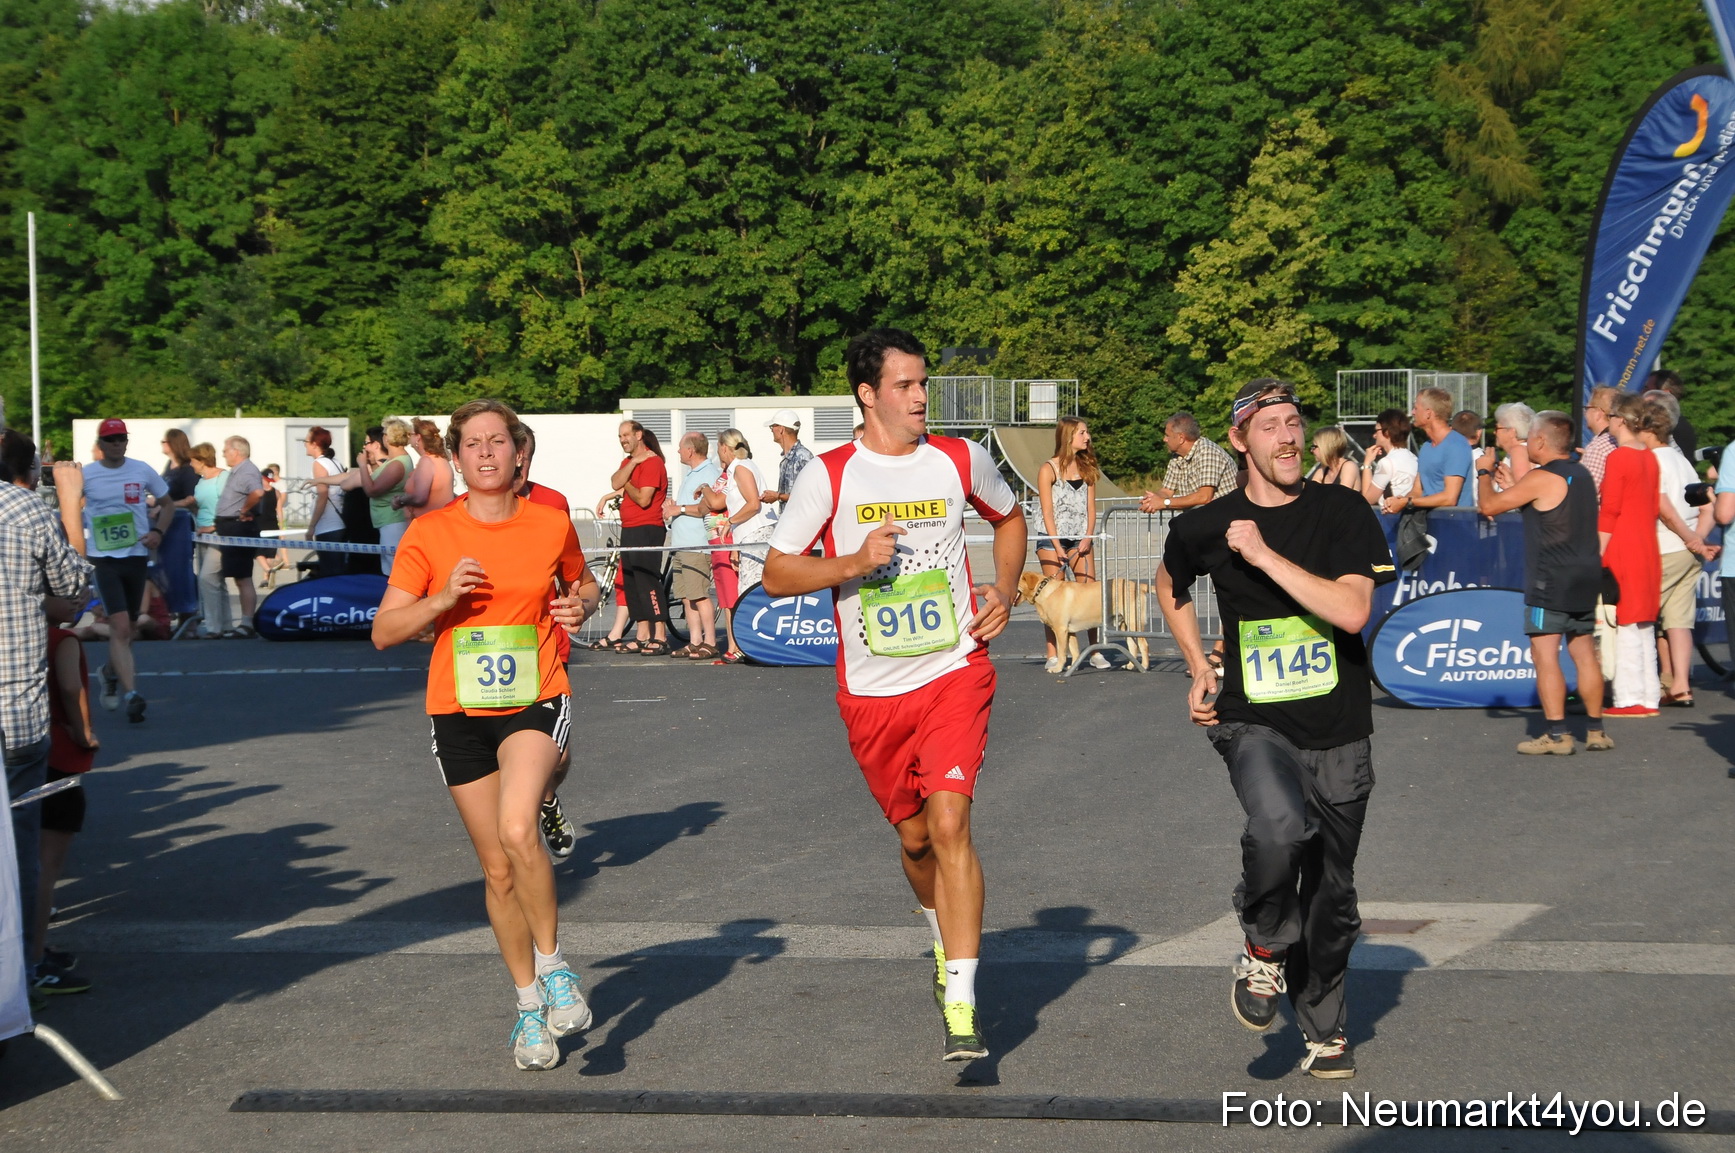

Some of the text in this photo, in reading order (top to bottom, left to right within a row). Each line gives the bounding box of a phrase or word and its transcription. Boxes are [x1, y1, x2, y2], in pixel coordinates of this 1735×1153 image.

[1669, 194, 1700, 239] Druck
[1592, 163, 1708, 342] Frischmann
[861, 502, 939, 520] ONLINE
[906, 520, 947, 529] Germany
[101, 525, 129, 541] 156
[877, 600, 941, 637] 916
[476, 654, 517, 687] 39
[1246, 641, 1332, 682] 1145
[944, 773, 966, 781] adidas
